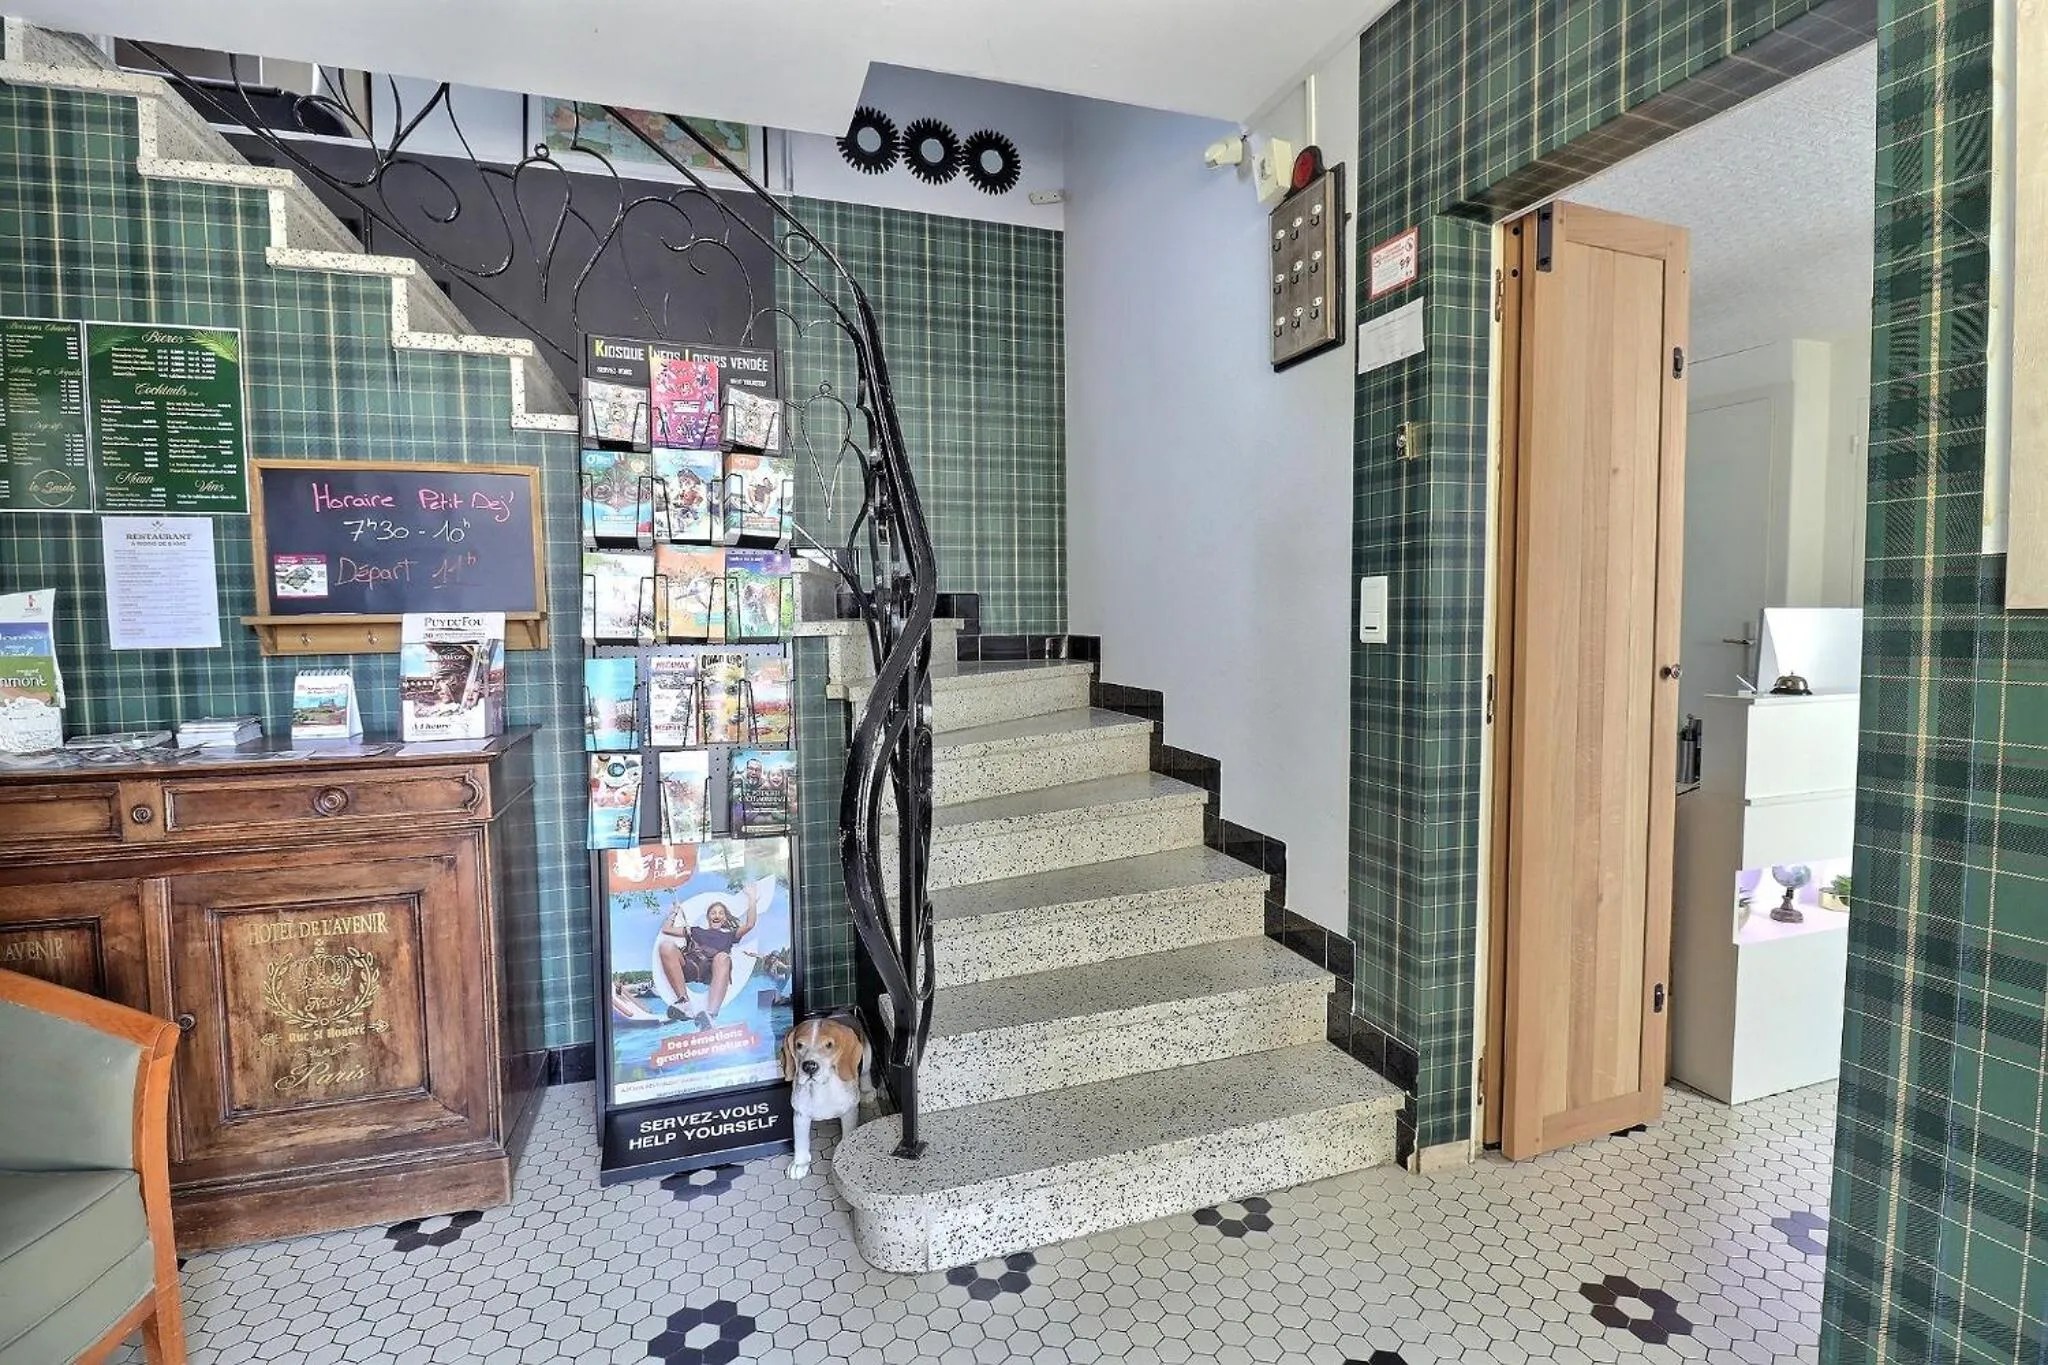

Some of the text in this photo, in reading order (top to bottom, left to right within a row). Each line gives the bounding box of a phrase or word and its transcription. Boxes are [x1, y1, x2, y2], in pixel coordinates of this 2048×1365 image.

[595, 339, 645, 361] KIOSQUE
[730, 355, 768, 372] VENDÉE
[135, 383, 187, 396] Cocktails
[194, 480, 225, 492] Vins
[312, 483, 396, 513] Horaire
[419, 489, 463, 510] Petit
[344, 519, 409, 542] 7h30
[433, 518, 470, 543] 10h
[300, 920, 320, 939] DE
[314, 1028, 323, 1041] St
[667, 1029, 743, 1051] Des émotions
[656, 1045, 710, 1067] grandeur
[711, 1039, 749, 1053] nature
[275, 1061, 368, 1090] Paris
[640, 1102, 770, 1134] SERVEZ-VOUS
[628, 1115, 779, 1151] HELP YOURSELF
